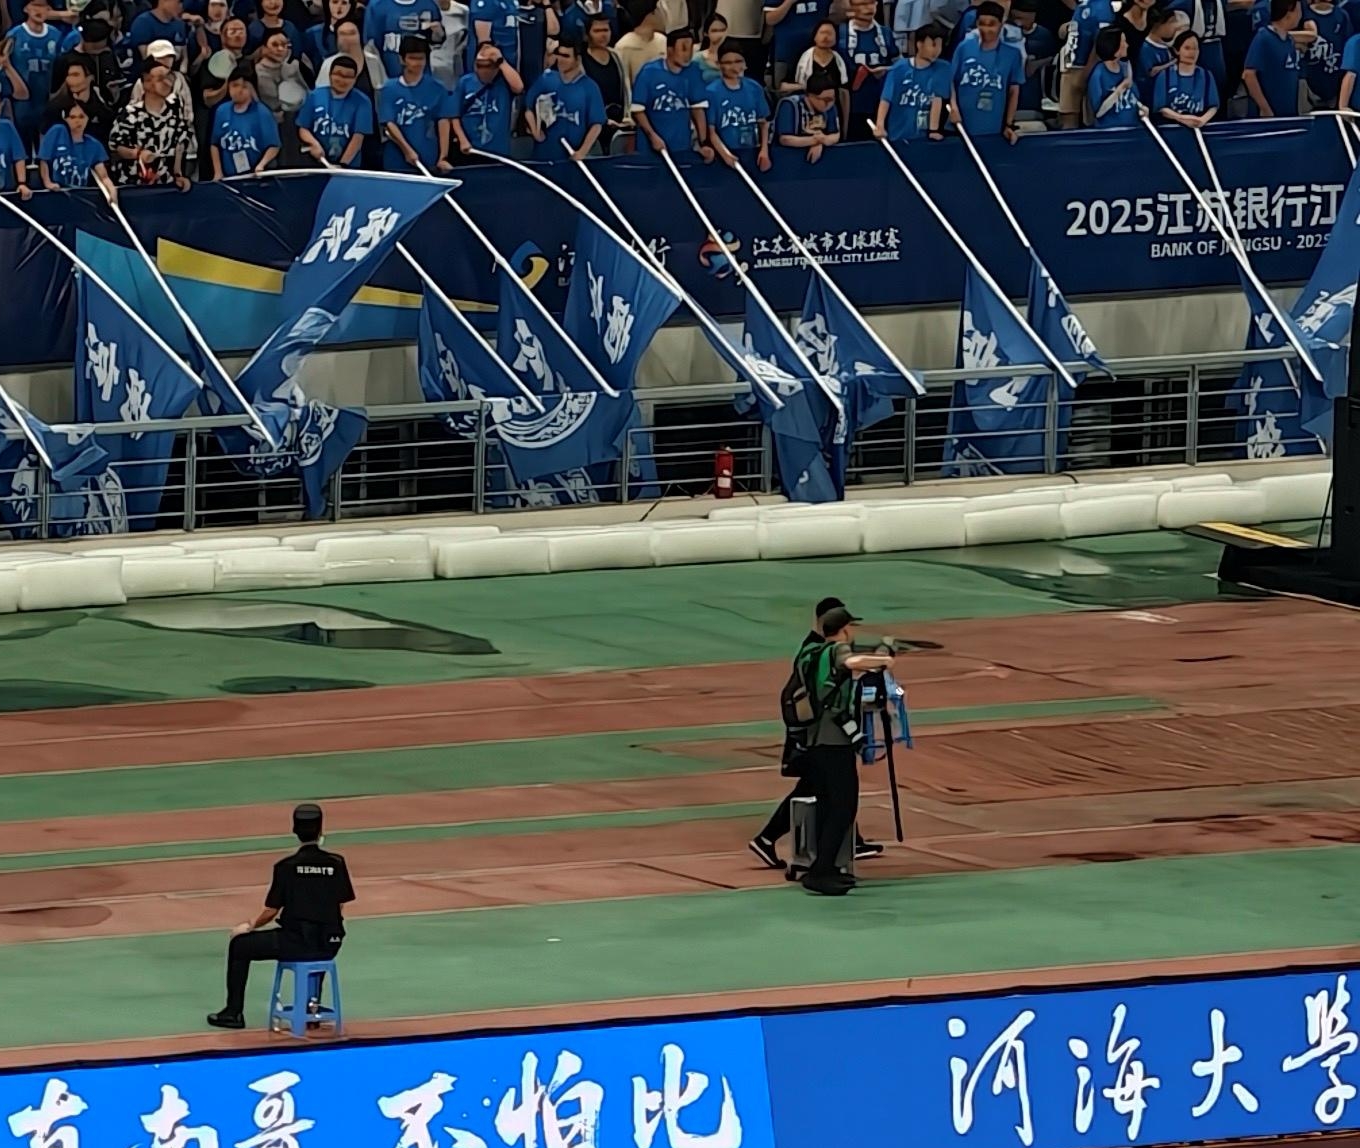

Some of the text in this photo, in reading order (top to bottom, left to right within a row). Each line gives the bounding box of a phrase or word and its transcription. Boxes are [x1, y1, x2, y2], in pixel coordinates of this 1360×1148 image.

[1151, 241, 1194, 258] BANK
[1197, 240, 1218, 255] OF
[1218, 236, 1282, 256] JINGSU
[842, 253, 862, 263] CITY
[863, 251, 900, 262] LEAGUE
